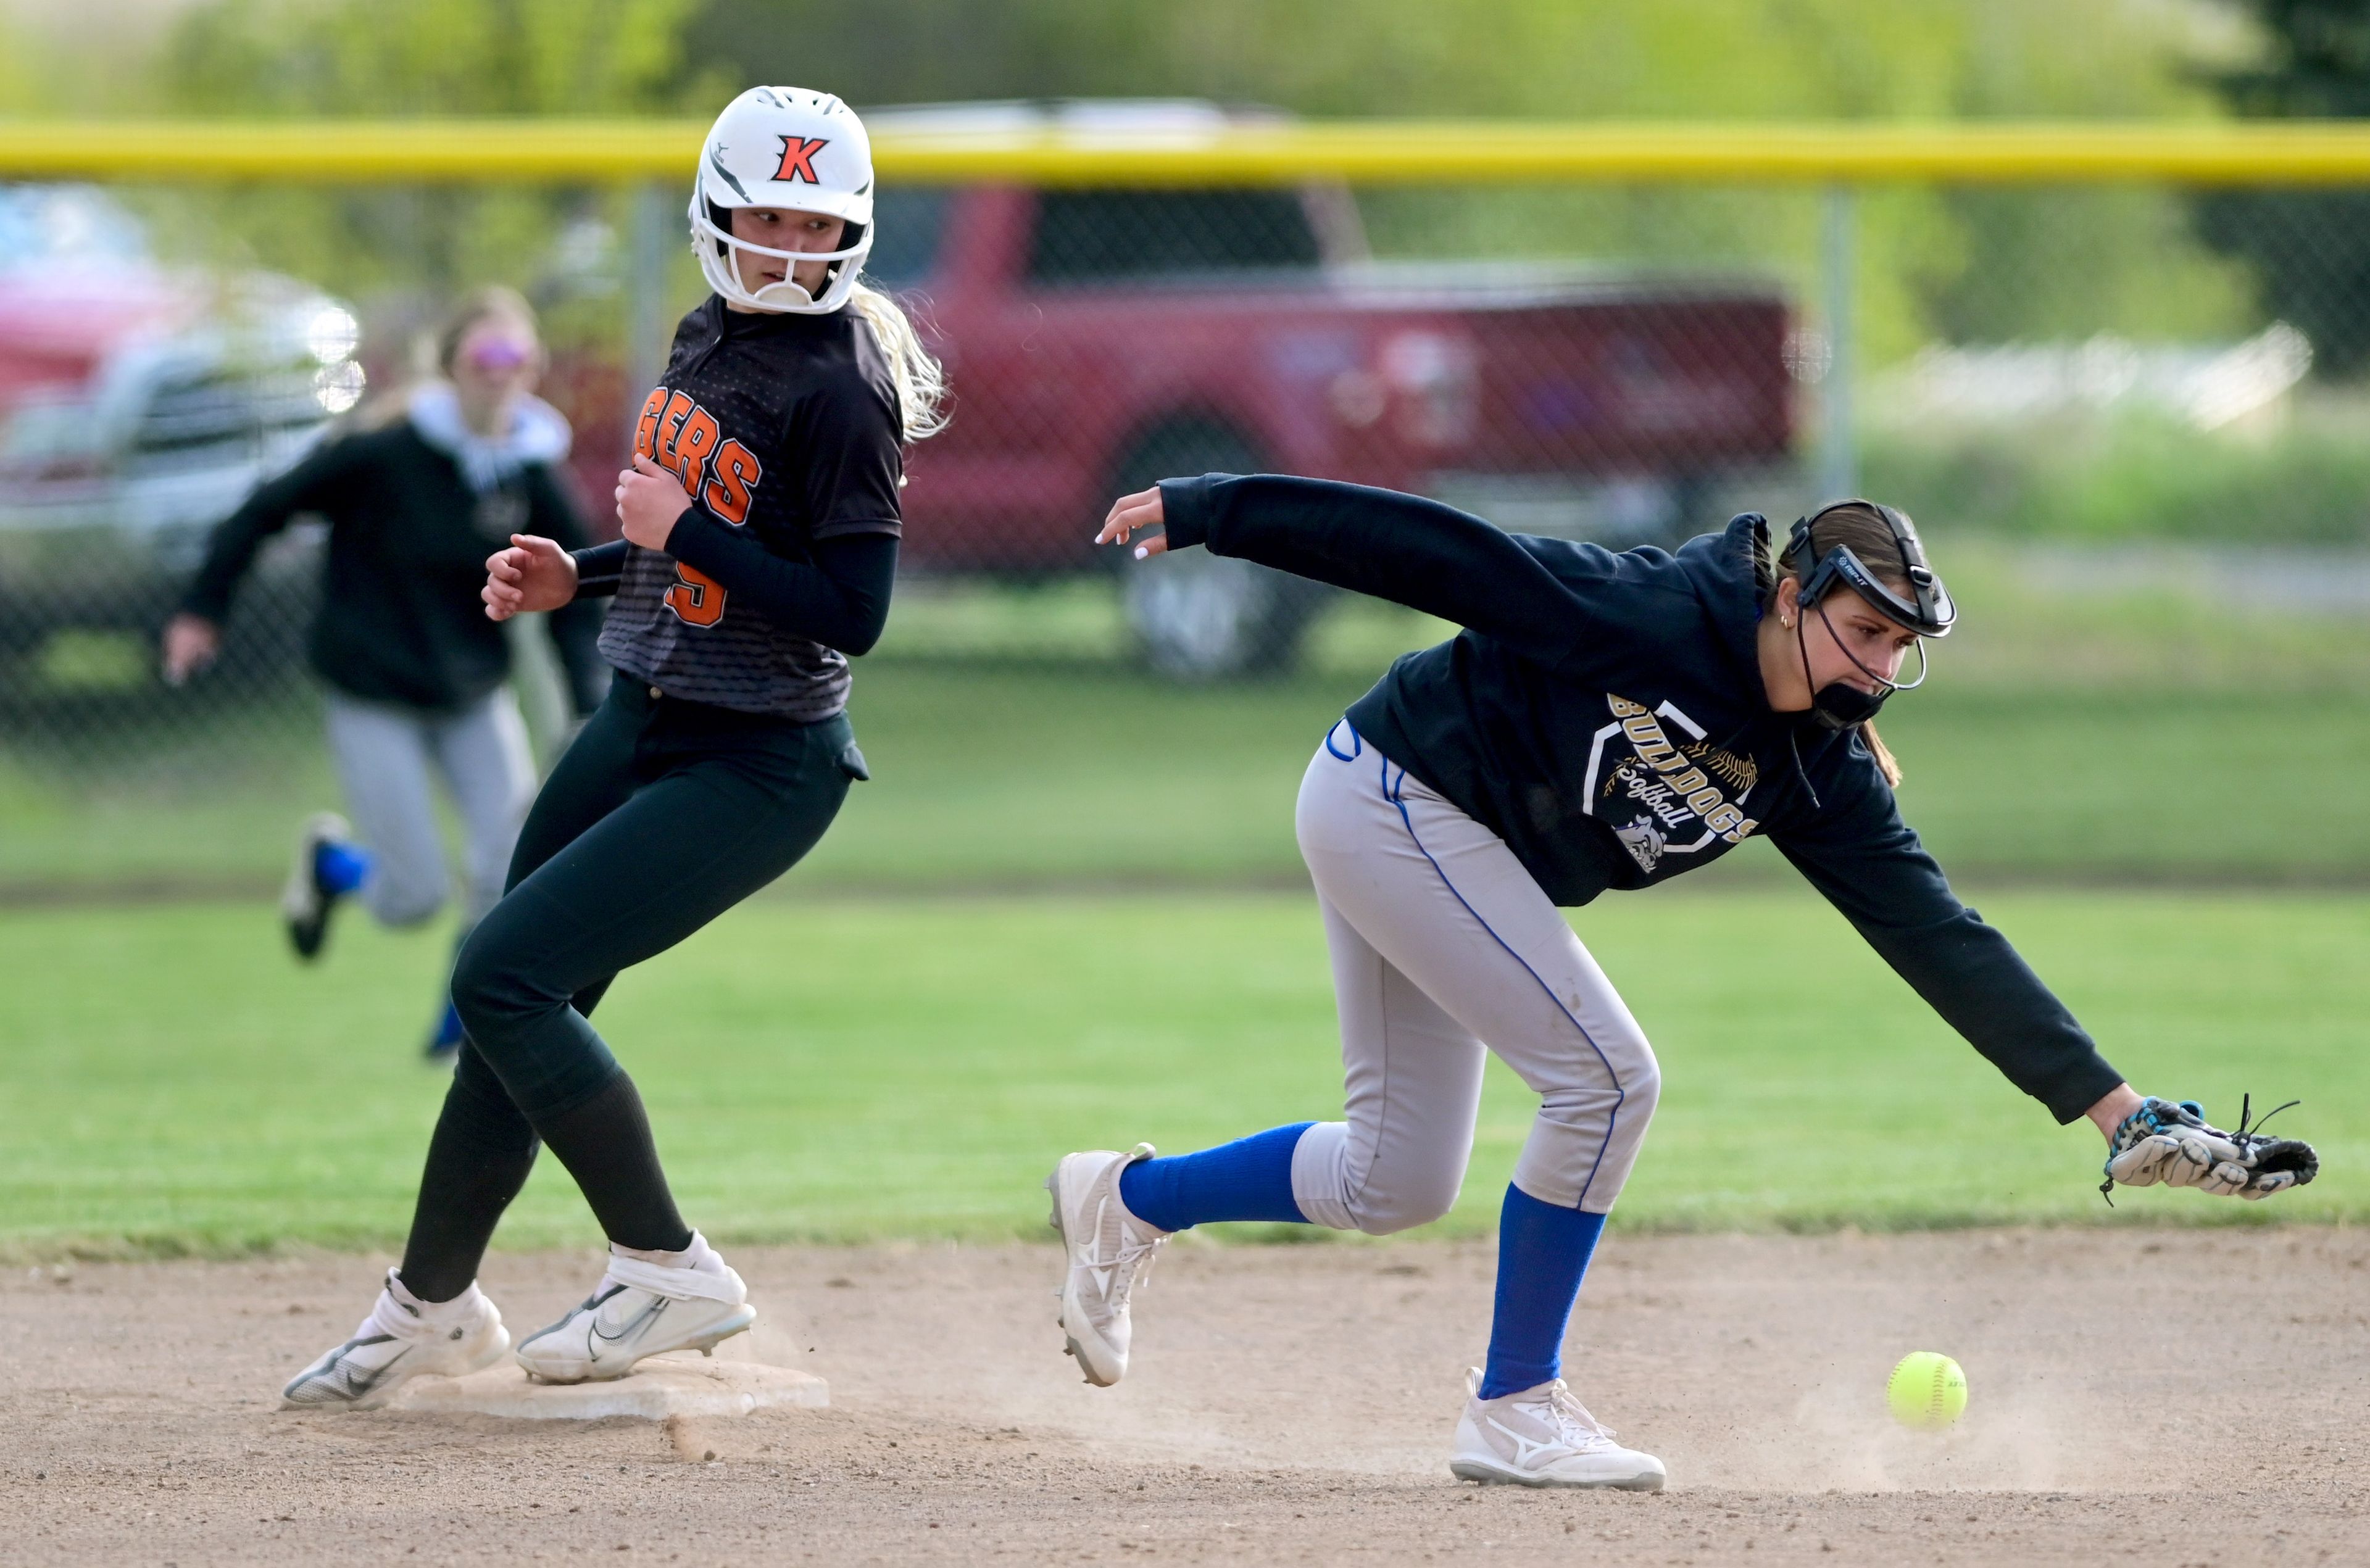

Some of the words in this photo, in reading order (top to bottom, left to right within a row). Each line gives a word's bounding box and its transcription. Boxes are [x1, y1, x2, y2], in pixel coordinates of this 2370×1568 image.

[769, 134, 831, 185] K
[1845, 564, 1868, 586] RIP-IT
[1618, 761, 1695, 829] Softball
